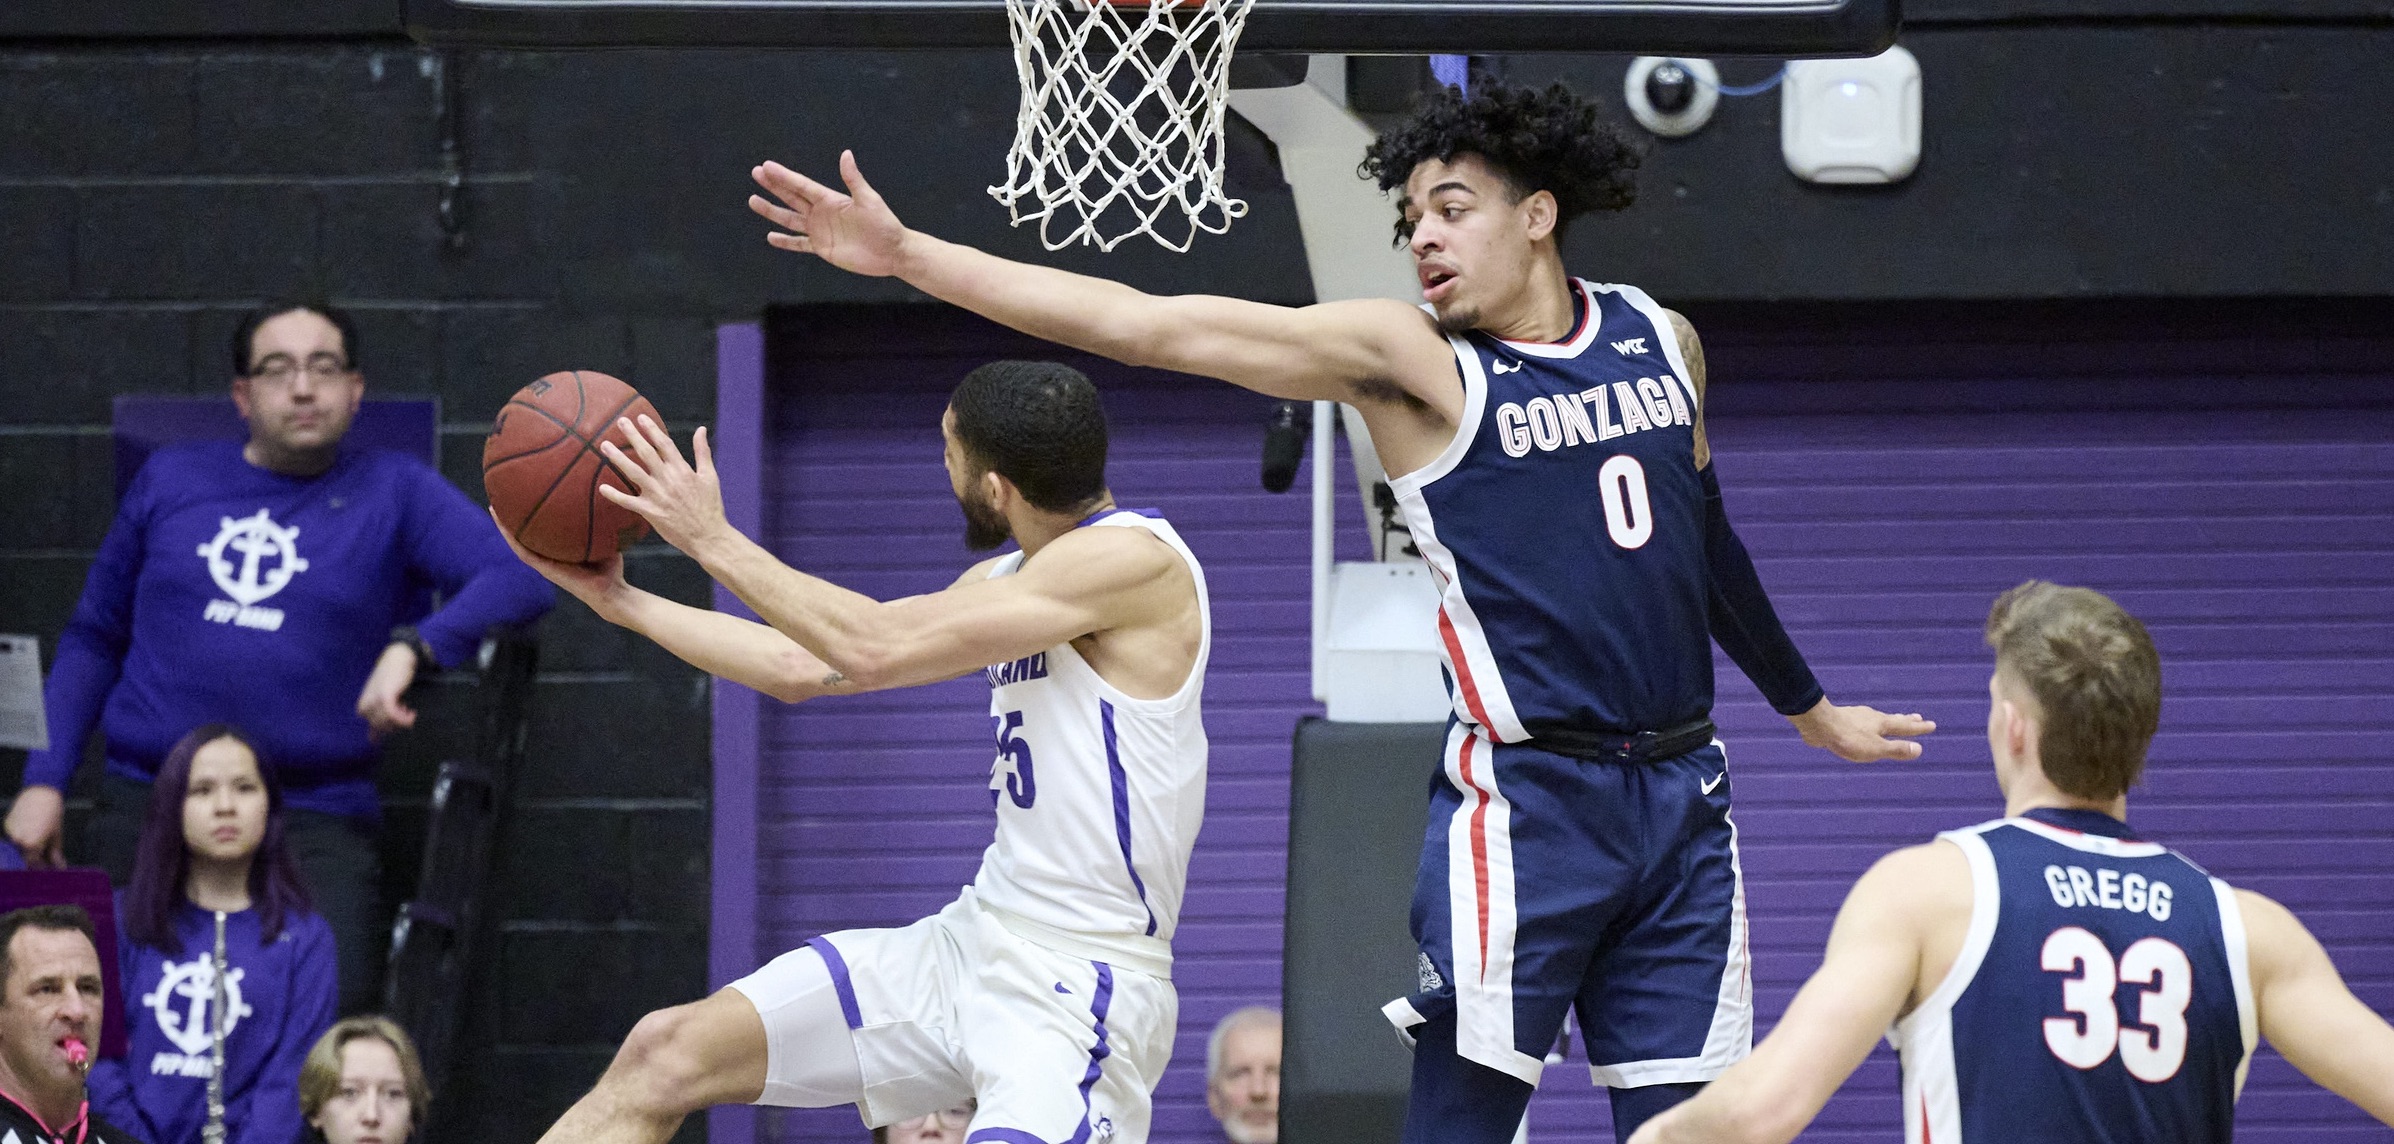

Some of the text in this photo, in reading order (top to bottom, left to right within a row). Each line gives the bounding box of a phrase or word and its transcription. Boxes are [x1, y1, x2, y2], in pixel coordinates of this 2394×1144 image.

[1610, 337, 1649, 356] WCC
[1496, 375, 1691, 458] GONZAGA
[1598, 454, 1653, 550] 0
[2044, 864, 2173, 922] GREGG
[2040, 925, 2192, 1083] 33
